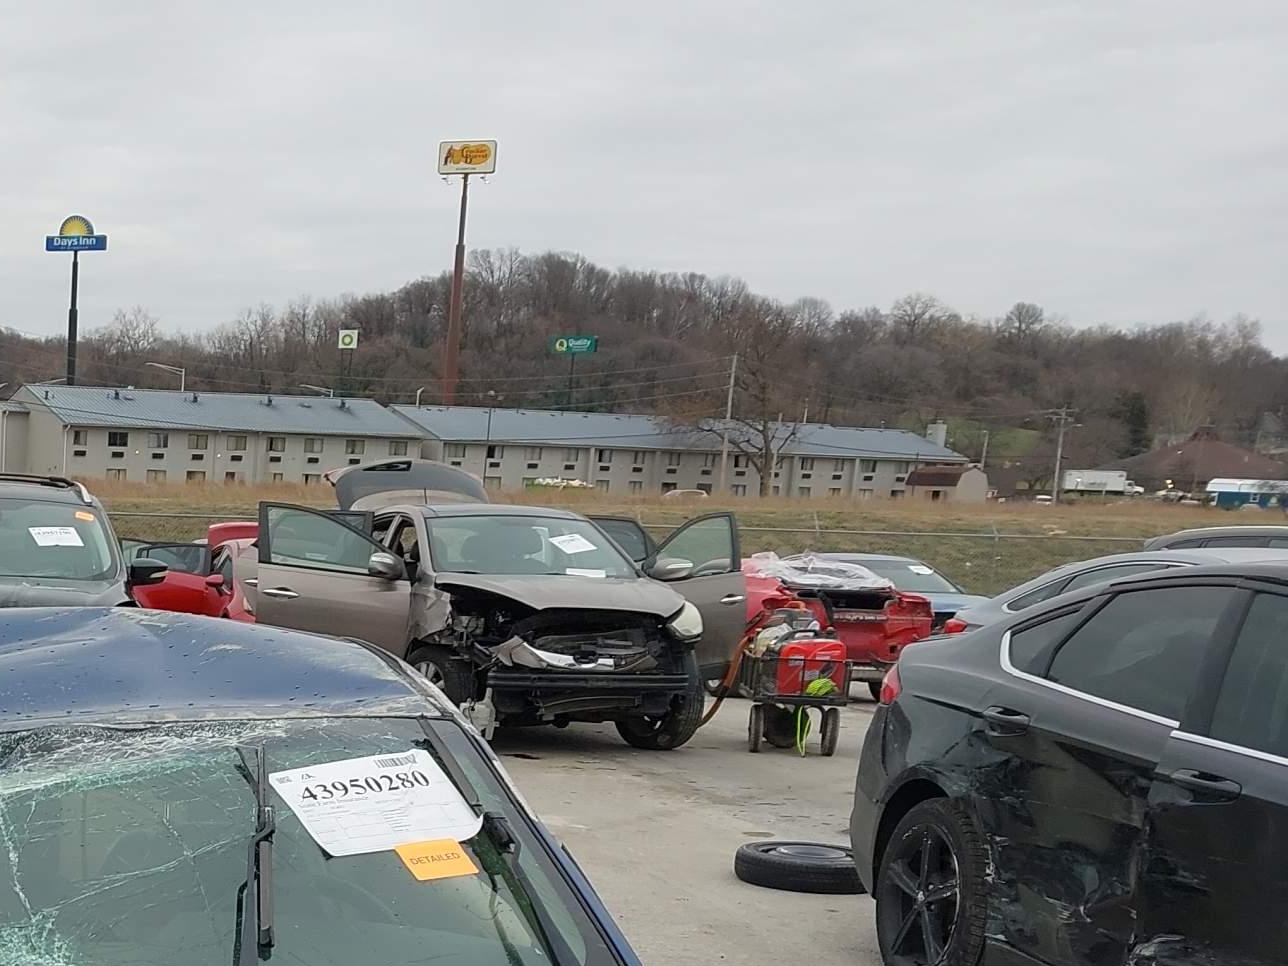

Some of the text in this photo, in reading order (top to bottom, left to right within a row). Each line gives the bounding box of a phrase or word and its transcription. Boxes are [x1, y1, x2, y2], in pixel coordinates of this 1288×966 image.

[53, 235, 97, 248] Days Inn
[300, 769, 431, 802] 43950280
[409, 852, 461, 866] DETAILED
